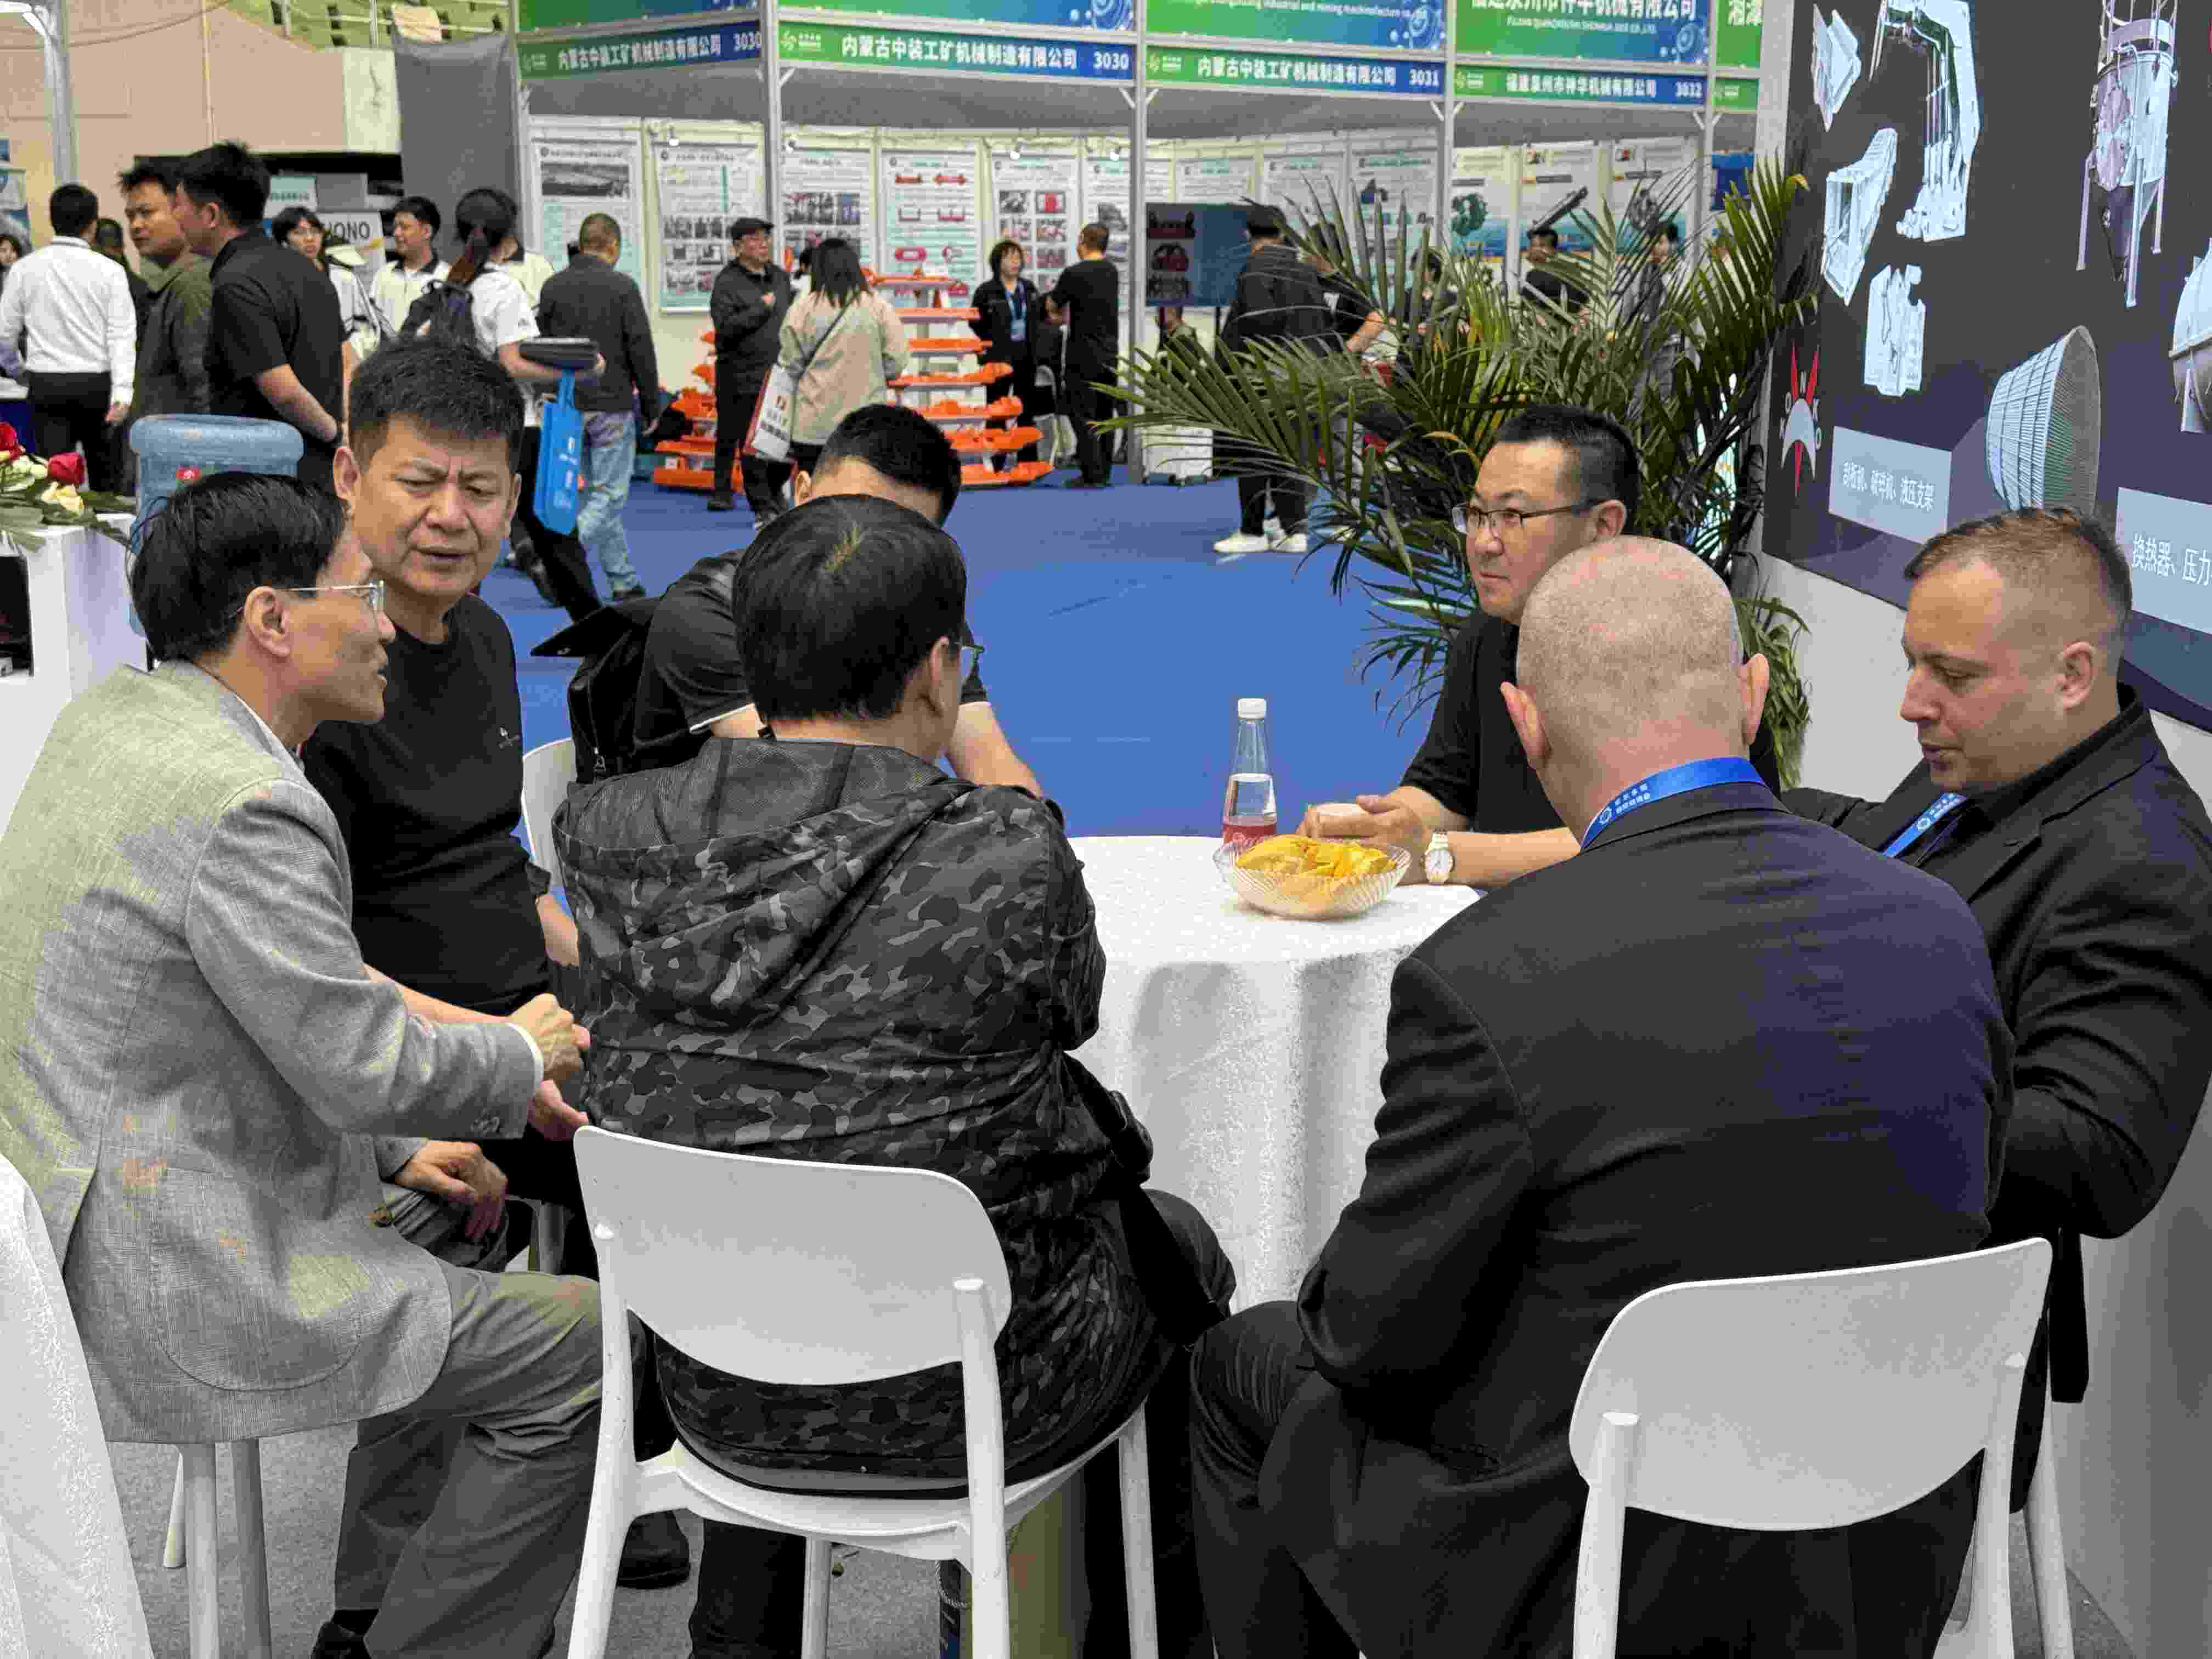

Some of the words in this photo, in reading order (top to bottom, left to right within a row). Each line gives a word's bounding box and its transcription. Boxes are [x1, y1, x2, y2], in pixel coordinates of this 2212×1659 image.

[842, 32, 1077, 69] 内蒙古中装工矿机械制造有限公司
[1093, 51, 1129, 70] 3030
[1198, 55, 1396, 86] 内蒙古中装工矿机械制造有限公司
[1409, 67, 1440, 87] 3031
[1675, 81, 1702, 98] 3032
[328, 221, 370, 239] ONO
[2132, 532, 2212, 586] 换热器、压力
